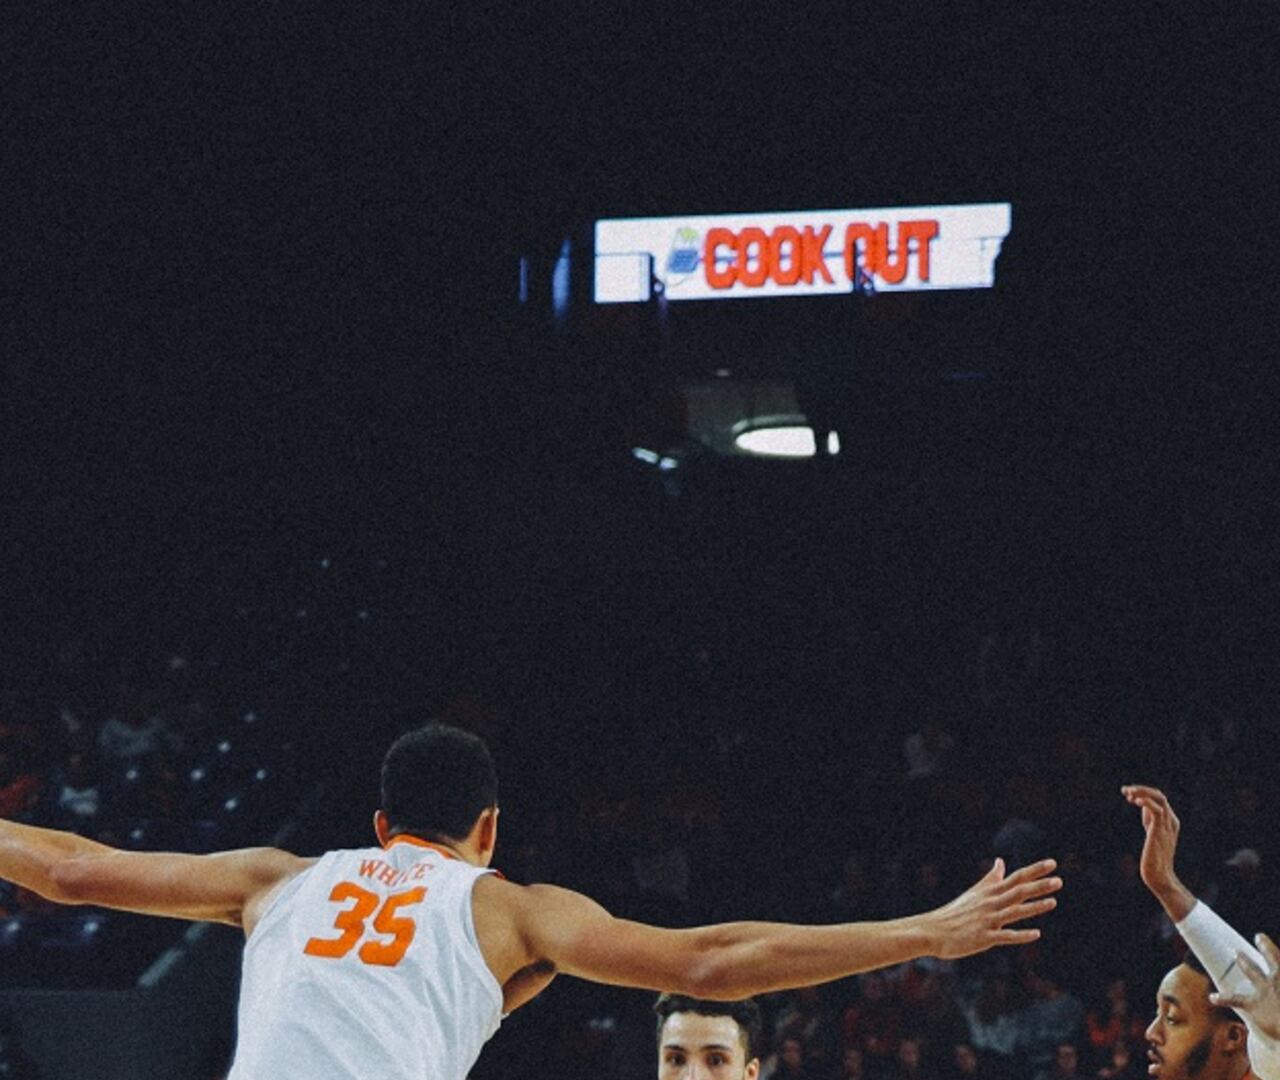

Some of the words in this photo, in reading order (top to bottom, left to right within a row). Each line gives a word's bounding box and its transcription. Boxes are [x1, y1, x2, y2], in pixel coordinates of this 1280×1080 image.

[704, 224, 835, 289] COOK
[843, 219, 939, 284] OUT
[303, 881, 428, 967] 35
